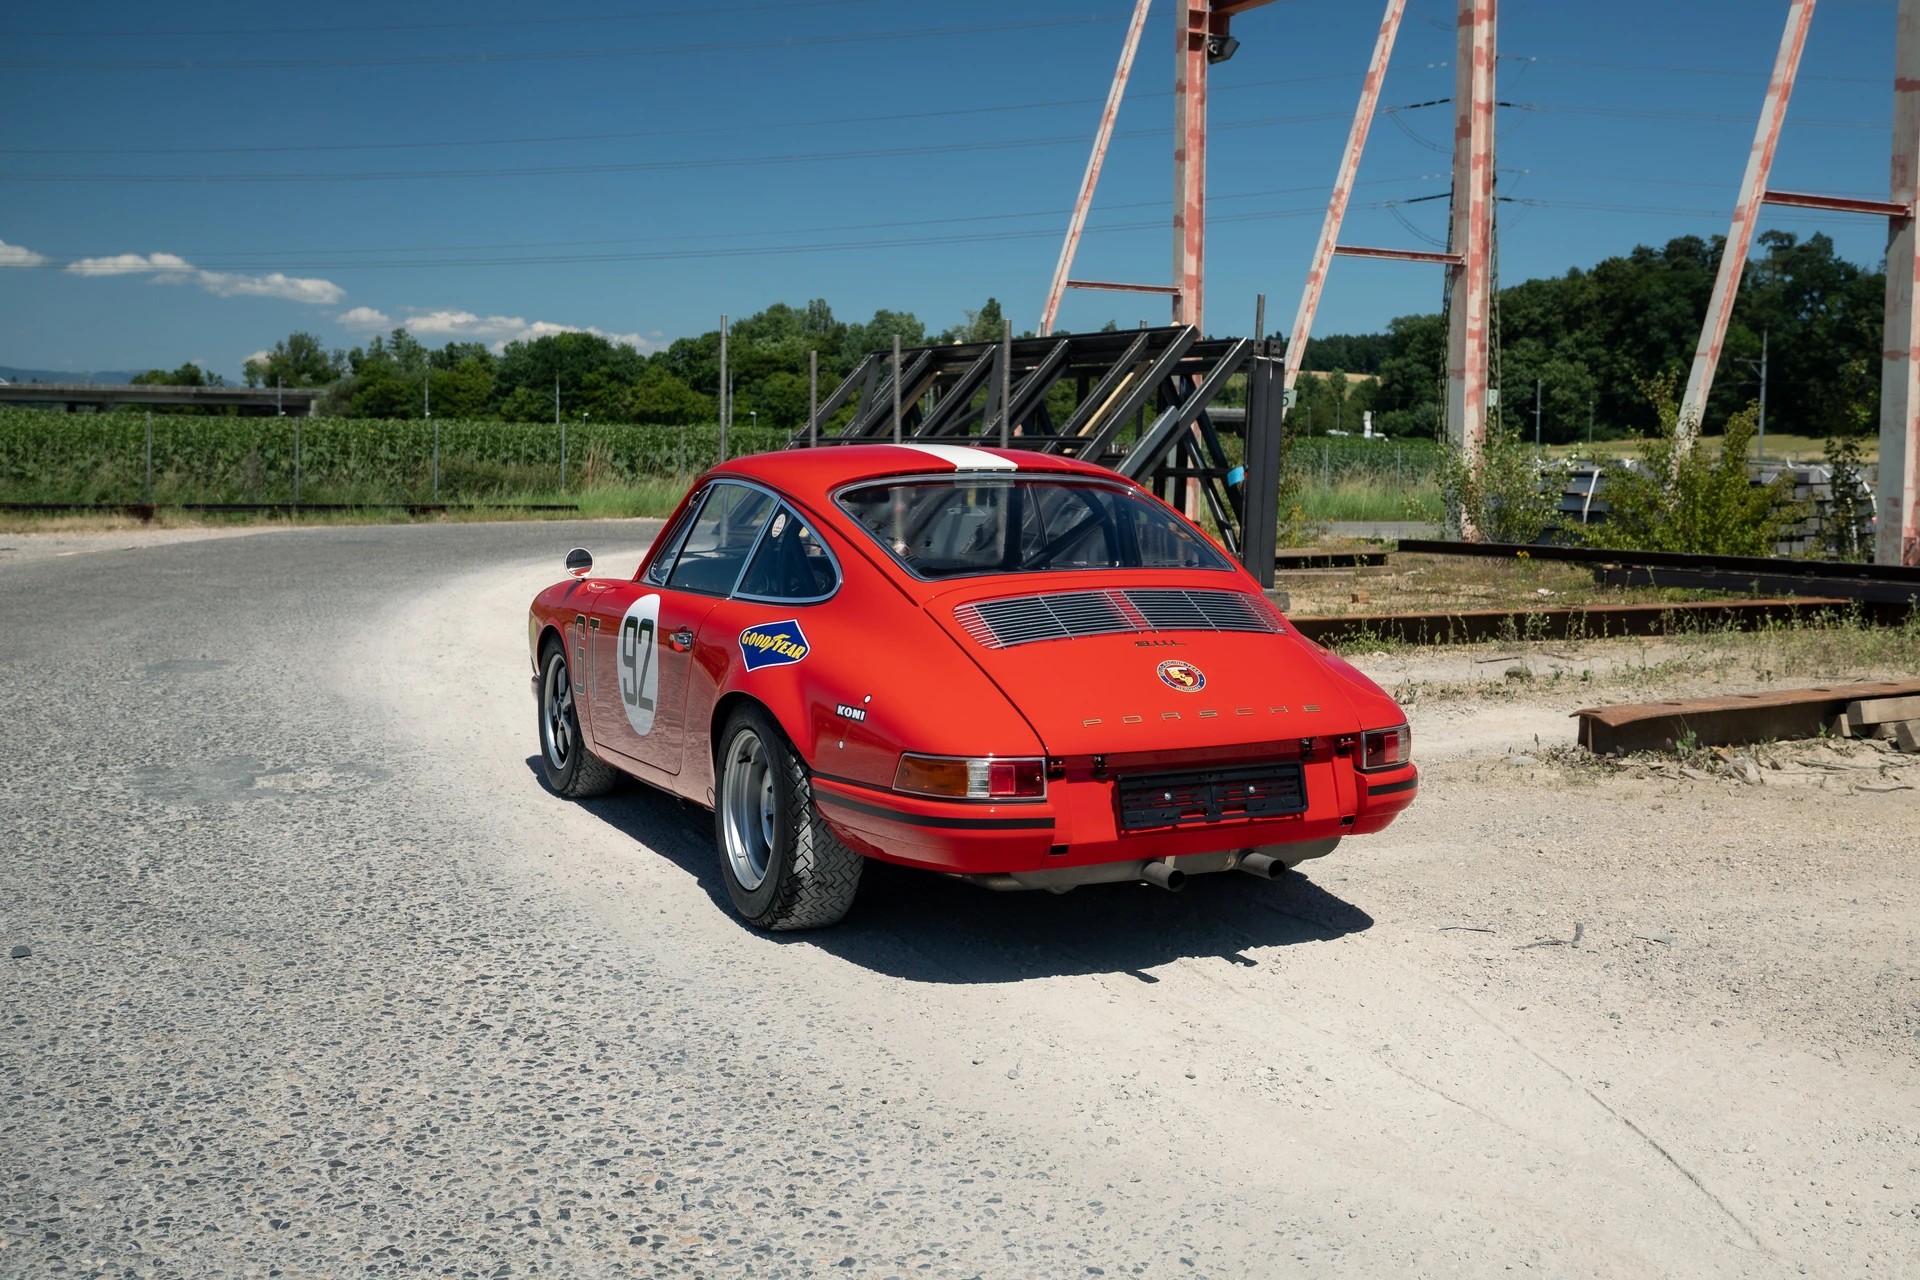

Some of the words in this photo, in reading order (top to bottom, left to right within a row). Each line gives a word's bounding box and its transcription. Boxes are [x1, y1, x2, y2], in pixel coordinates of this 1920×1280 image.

[574, 614, 600, 700] GT
[741, 630, 806, 660] GOODYEAR
[622, 616, 654, 712] 92
[837, 705, 866, 721] KONI
[1082, 704, 1322, 728] PORSCHE
